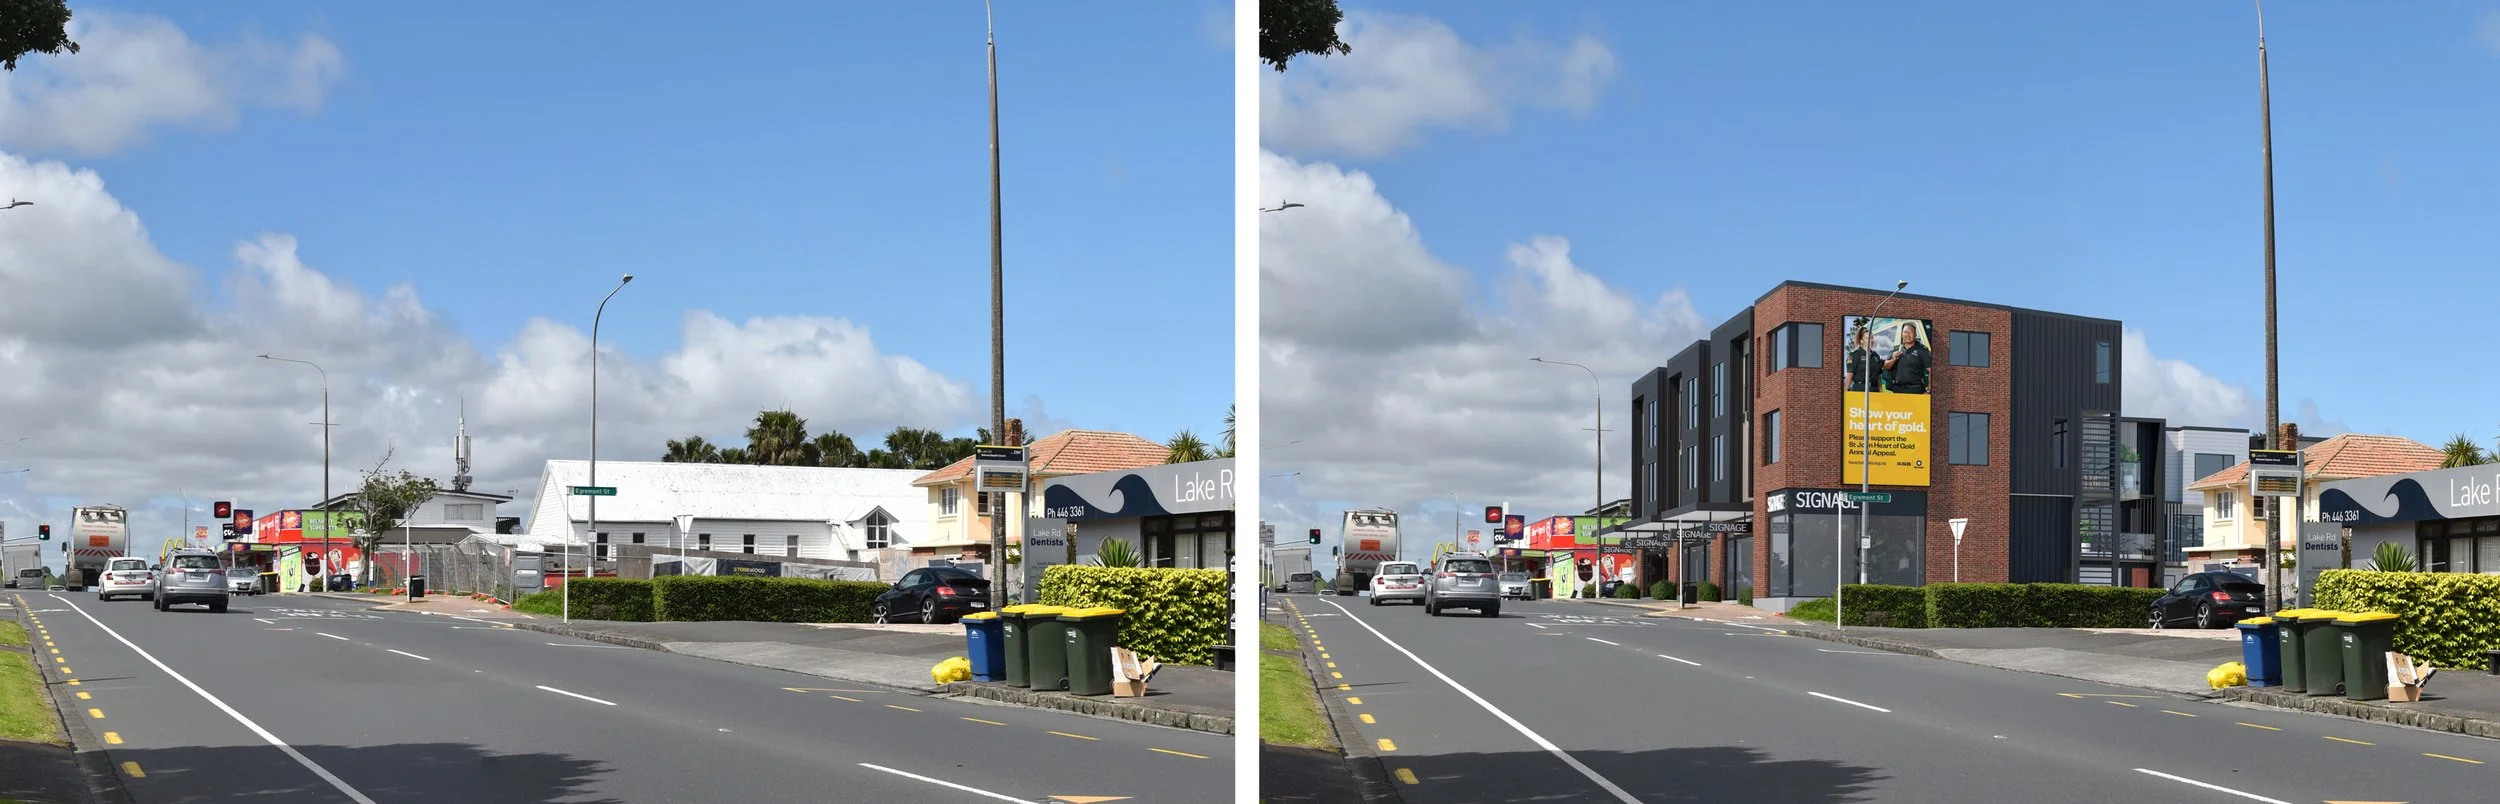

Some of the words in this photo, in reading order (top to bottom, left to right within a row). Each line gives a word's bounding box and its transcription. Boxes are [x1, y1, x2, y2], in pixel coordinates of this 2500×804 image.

[1849, 407, 1882, 418] Show
[1885, 411, 1913, 421] your
[1884, 421, 1898, 431] of
[1898, 422, 1927, 434] gold.
[1872, 449, 1896, 457] Appeal.
[1175, 471, 1215, 503] Lake
[1221, 469, 1234, 499] R
[2451, 476, 2491, 507] Lake
[1047, 508, 1056, 518] Ph
[1057, 506, 1069, 518] 446
[1070, 505, 1085, 517] 3361
[2322, 511, 2331, 522] Ph
[2332, 511, 2344, 522] 446
[2344, 509, 2359, 521] 3361
[1709, 523, 1747, 532] SIGNAGE
[1033, 528, 1050, 537] Lake
[1051, 528, 1061, 537] Rd
[1676, 530, 1712, 539] SIGNAGE
[2307, 532, 2325, 541] Lake
[2326, 532, 2336, 541] Rd
[1031, 538, 1064, 546] Dentists
[2305, 542, 2339, 550] Dentists
